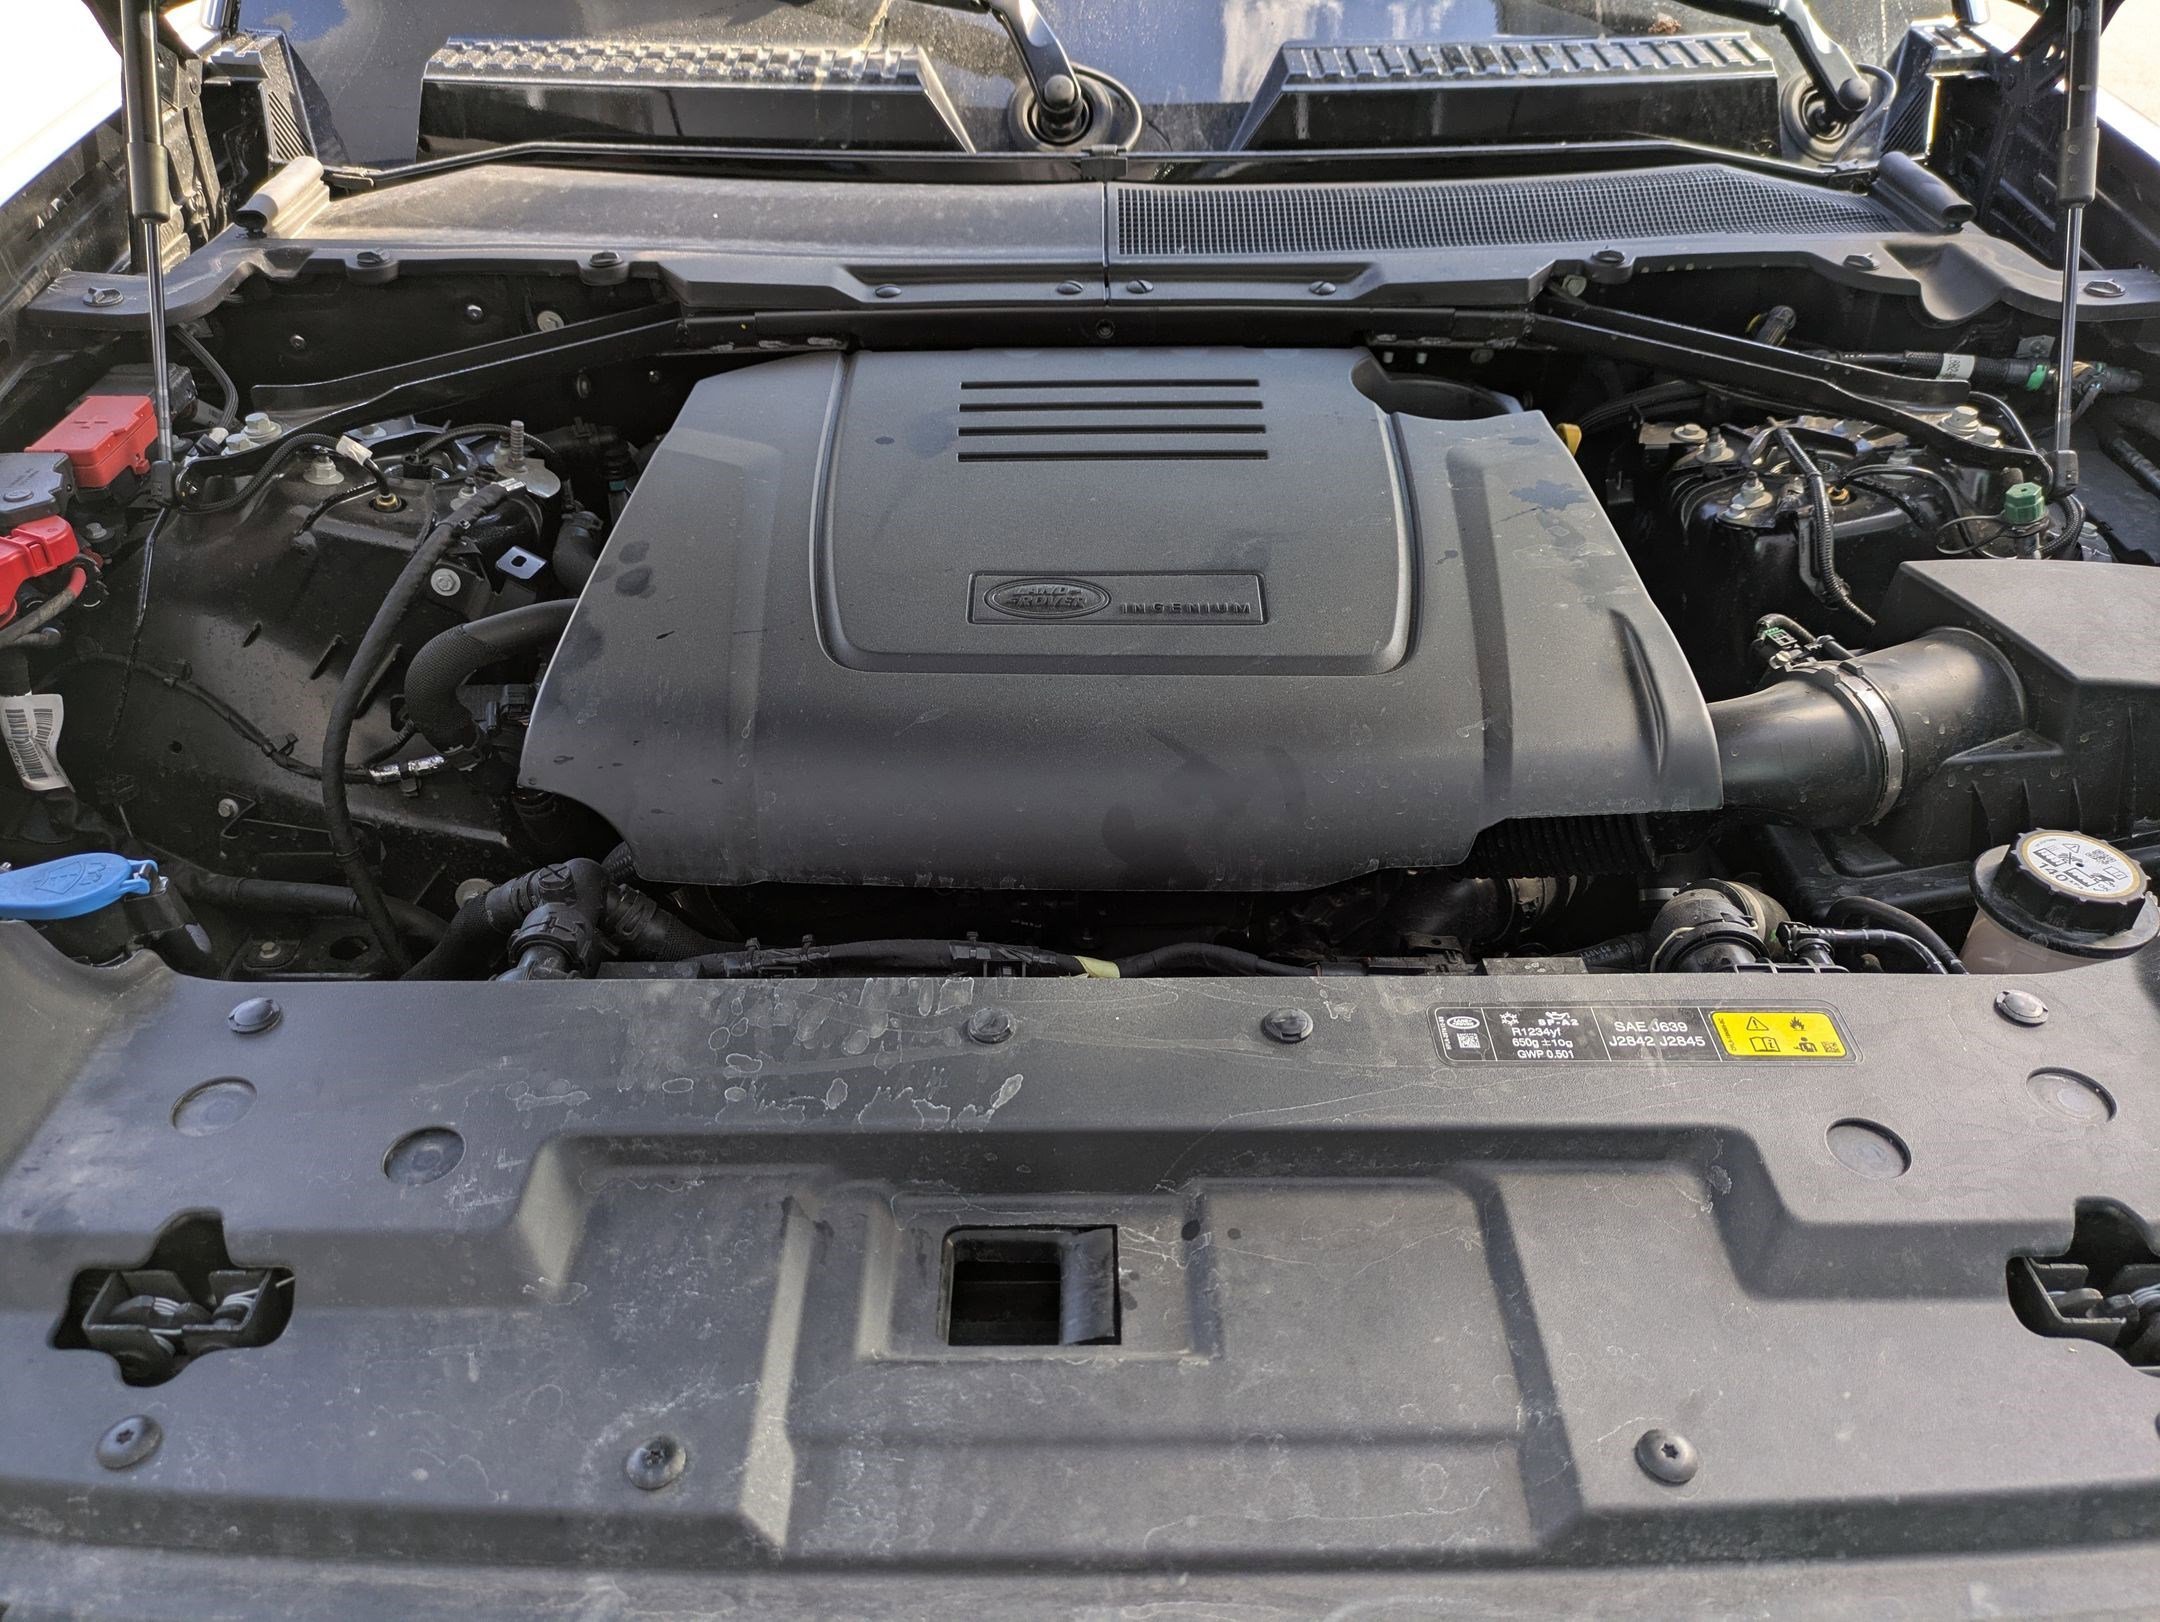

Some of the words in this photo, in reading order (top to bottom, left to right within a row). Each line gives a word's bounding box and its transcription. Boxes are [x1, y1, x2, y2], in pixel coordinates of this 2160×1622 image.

[1119, 601, 1252, 615] INGENIUM
[2039, 862, 2068, 882] 140
[1613, 1021, 1649, 1033] SAE
[1651, 1020, 1688, 1033] J639
[1511, 1037, 1540, 1049] 650g
[1608, 1035, 1656, 1048] J2842
[1659, 1035, 1706, 1048] J2845
[1516, 1049, 1545, 1060] GWP
[1545, 1049, 1575, 1060] 0.501
